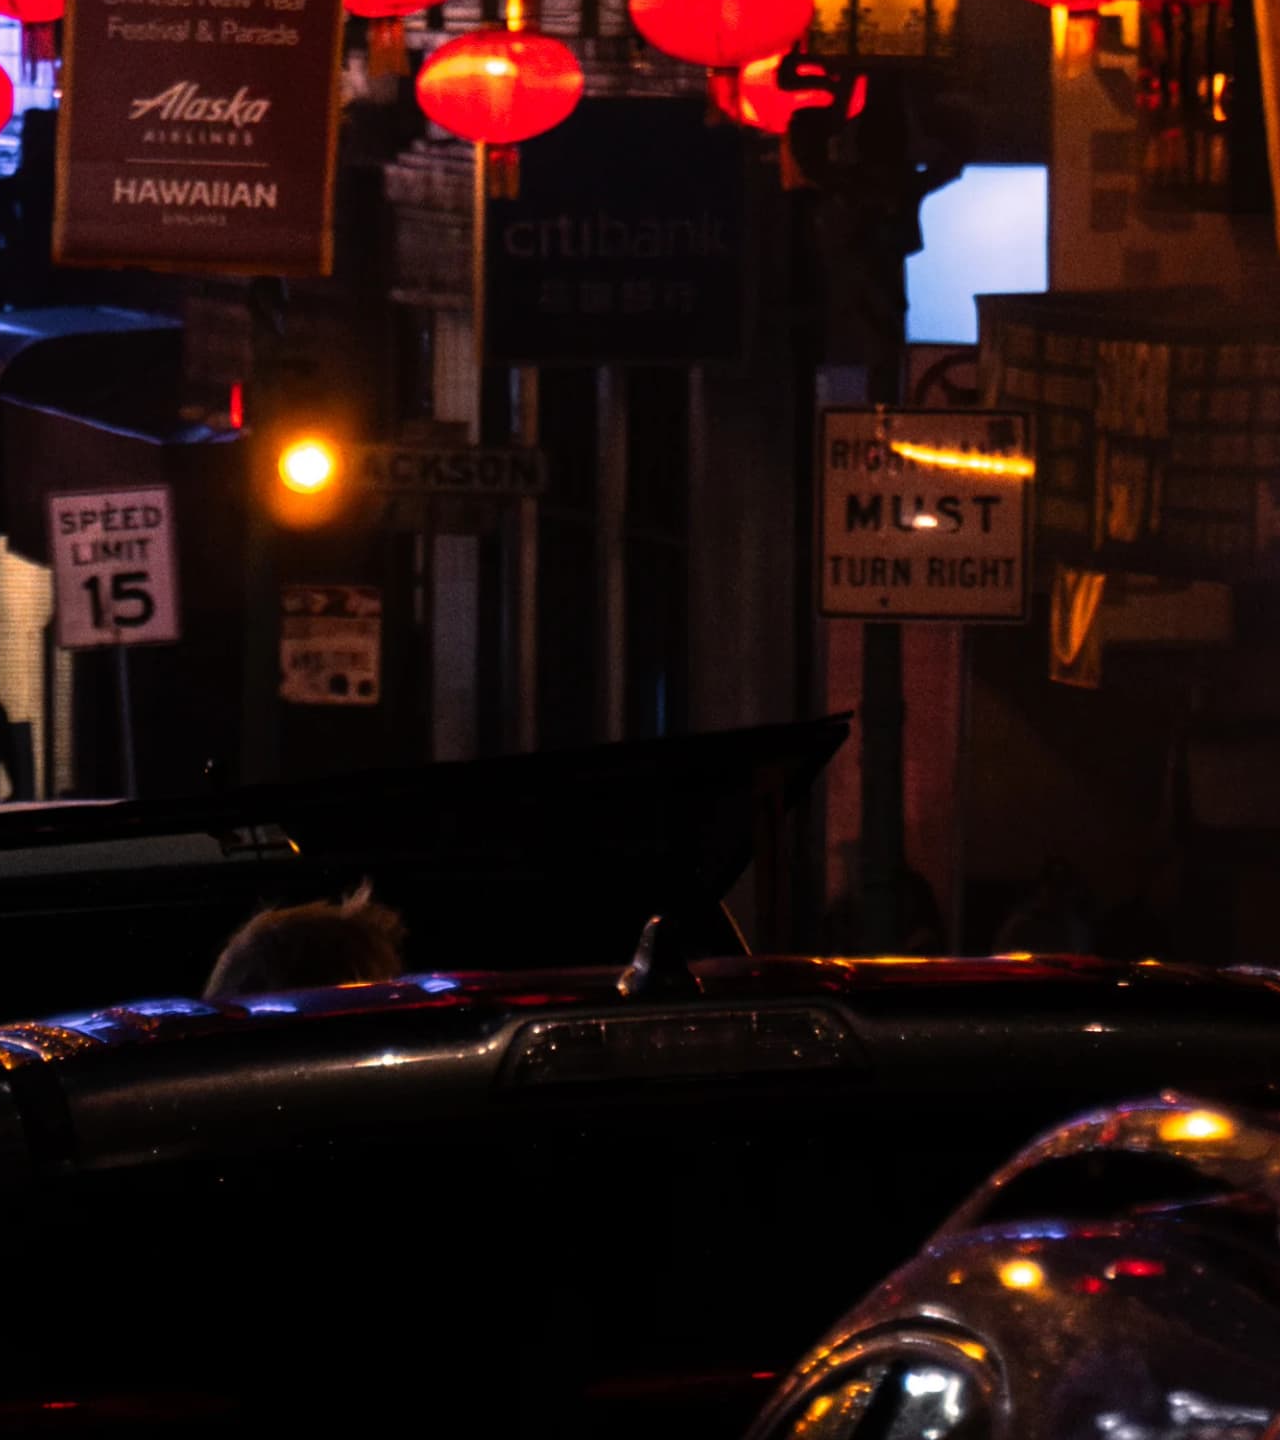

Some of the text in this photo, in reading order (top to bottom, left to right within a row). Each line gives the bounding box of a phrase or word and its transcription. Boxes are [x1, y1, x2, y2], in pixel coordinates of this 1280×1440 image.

[107, 15, 191, 43] Festival
[127, 80, 274, 129] Alaska
[112, 177, 279, 210] HAWAIIAN
[61, 504, 164, 535] SPEED
[846, 493, 1002, 534] MUST
[71, 537, 150, 567] LIMIT
[829, 556, 1015, 588] TURN RIGHT
[83, 570, 155, 629] 15
